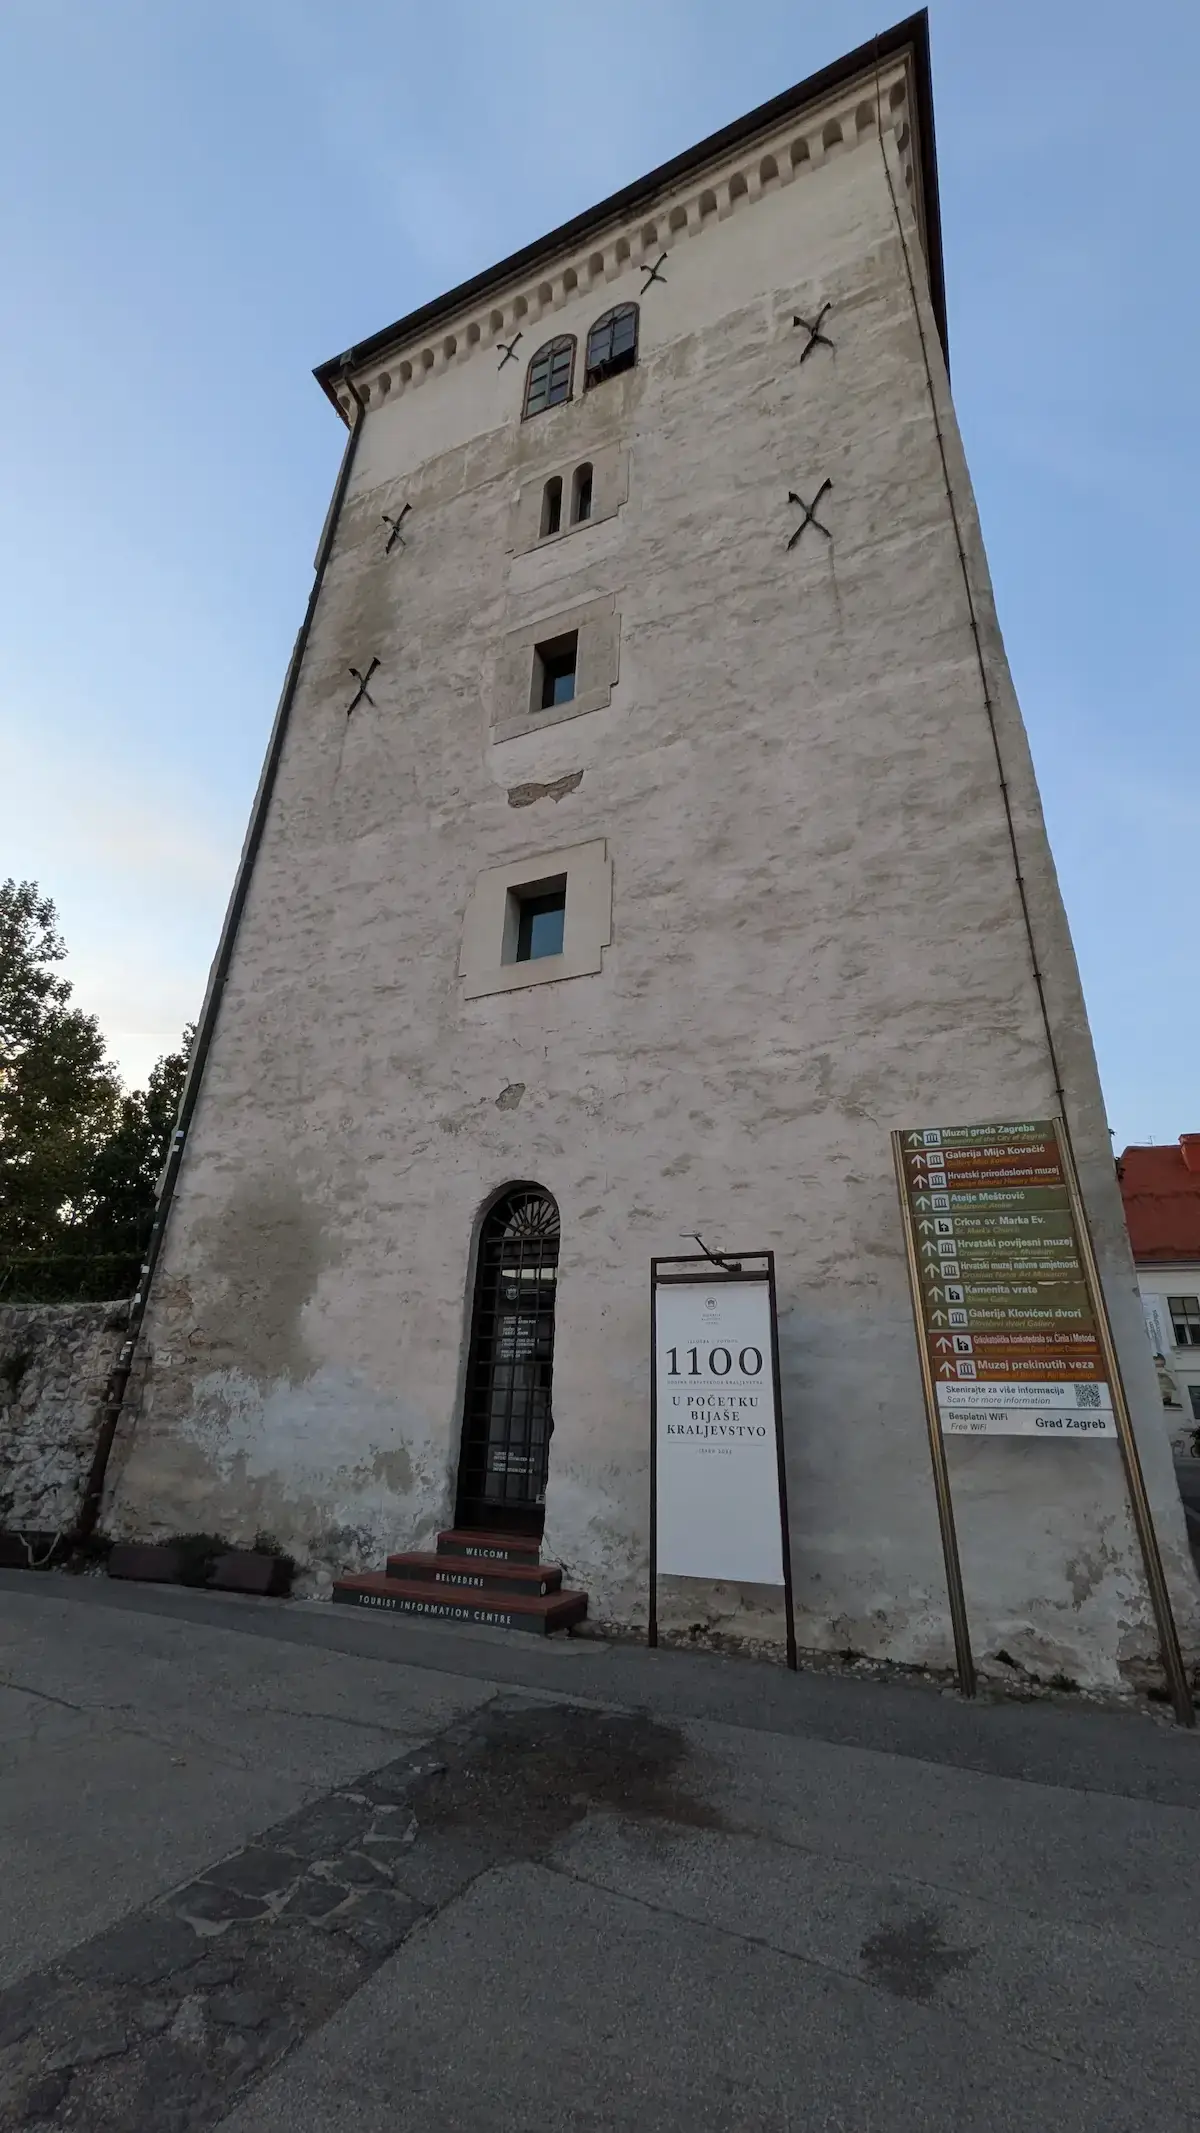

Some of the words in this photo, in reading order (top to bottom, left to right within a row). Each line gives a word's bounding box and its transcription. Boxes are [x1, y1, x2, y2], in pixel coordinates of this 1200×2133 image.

[942, 1128, 969, 1138] Muzej
[971, 1127, 996, 1136] grada
[998, 1124, 1035, 1134] Zagreba
[946, 1150, 981, 1160] Galerija
[984, 1148, 1005, 1158] Mijo
[1008, 1144, 1045, 1154] Kovačić
[948, 1170, 980, 1180] Hrvatski
[981, 1166, 1032, 1178] prirodoslovni
[1034, 1166, 1060, 1175] muzej
[979, 1191, 1025, 1201] Meštrović
[954, 1218, 981, 1226] Crkva
[999, 1216, 1029, 1225] Marka
[1032, 1216, 1045, 1224] Ev.
[958, 1239, 996, 1248] Hrvatski
[998, 1238, 1041, 1248] povijesni
[1044, 1237, 1073, 1247] muzej
[960, 1261, 989, 1270] Hrvatski
[991, 1262, 1013, 1271] muzej
[1039, 1260, 1078, 1271] umjetnosti
[965, 1285, 1010, 1294] Kamenita
[1012, 1286, 1038, 1294] vrata
[969, 1309, 1006, 1319] Galerija
[1008, 1309, 1052, 1318] Klovićevi
[1055, 1309, 1082, 1318] dvori
[974, 1335, 1009, 1344] Grkokatolička
[1010, 1334, 1046, 1343] konkatedrala
[1046, 1335, 1054, 1343] sv.
[1074, 1333, 1095, 1342] Metoda
[666, 1346, 764, 1376] 1100
[977, 1360, 1009, 1371] Muzej
[1012, 1360, 1066, 1370] prekinutih
[1068, 1361, 1094, 1369] veza
[946, 1386, 986, 1394] Skenirajte
[999, 1386, 1015, 1394] više
[1018, 1386, 1064, 1395] informacija
[672, 1396, 681, 1406] U
[687, 1394, 759, 1407] POČETKU
[1003, 1396, 1051, 1404] information
[691, 1409, 740, 1423] BIJAŠE
[949, 1412, 987, 1422] Besplatni
[989, 1412, 1008, 1420] WiFi
[1035, 1418, 1062, 1428] Grad
[1066, 1418, 1106, 1430] Zagreb
[667, 1424, 766, 1438] KRALJEVSTVO
[466, 1547, 509, 1560] WELCOME
[435, 1573, 484, 1587] BELVEDERE
[359, 1594, 396, 1608] TOURIST
[400, 1601, 470, 1618] INFORMATION
[473, 1611, 512, 1625] CENTRE
